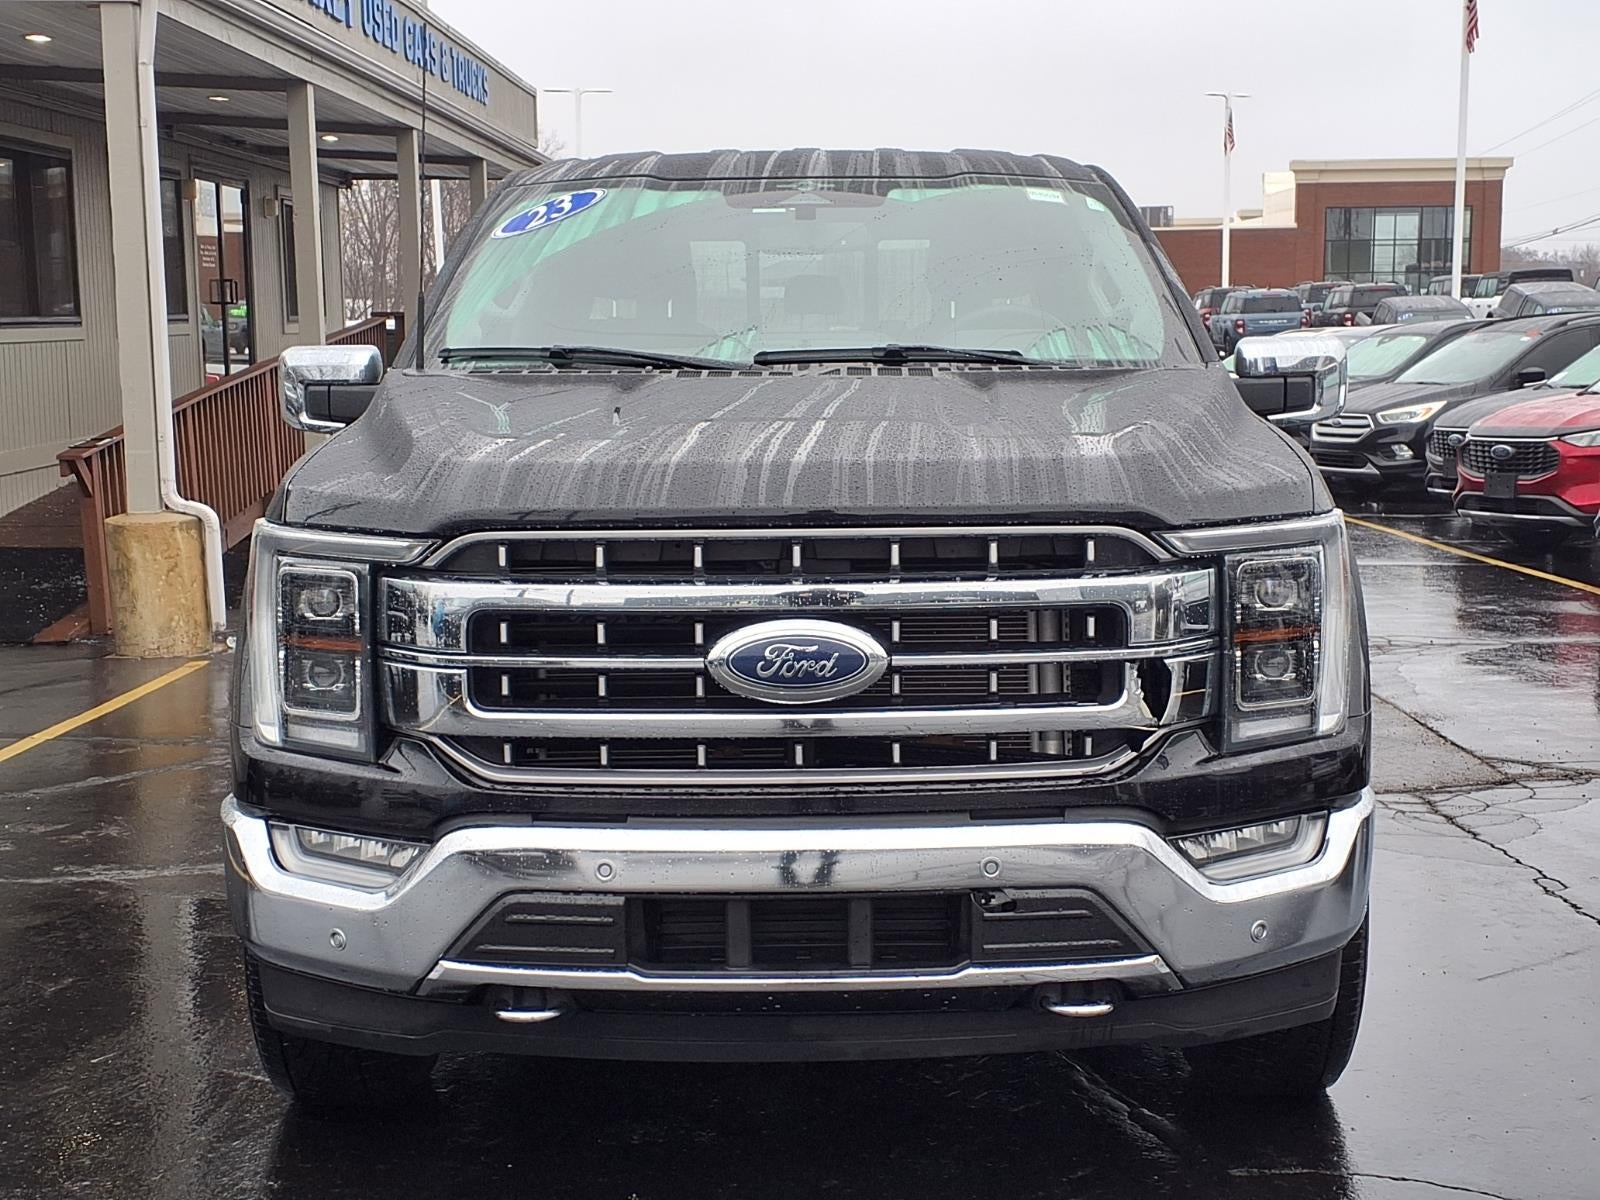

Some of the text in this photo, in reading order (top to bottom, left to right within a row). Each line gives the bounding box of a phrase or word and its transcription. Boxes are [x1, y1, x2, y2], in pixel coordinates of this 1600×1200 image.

[361, 0, 400, 54] USED
[440, 41, 450, 83] &
[449, 47, 489, 106] TRUCKS
[525, 194, 572, 229] 23
[756, 643, 839, 679] Ford
